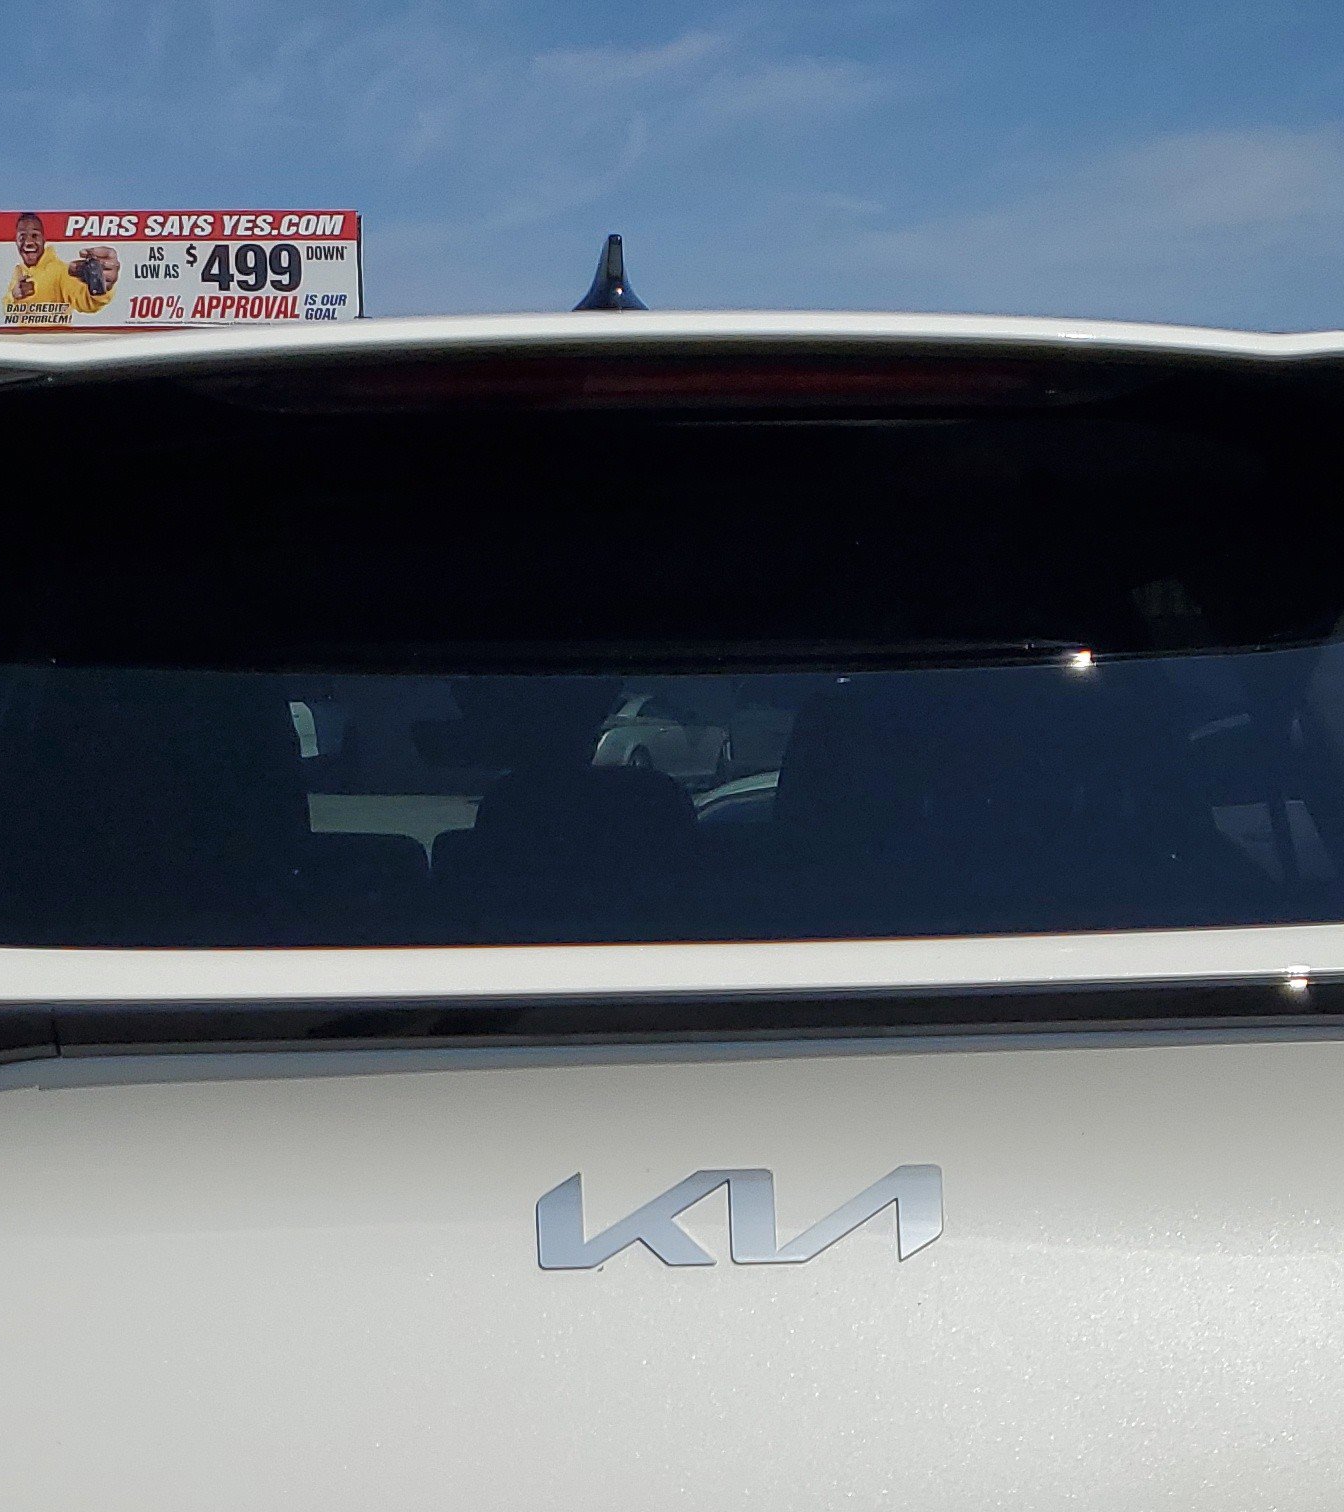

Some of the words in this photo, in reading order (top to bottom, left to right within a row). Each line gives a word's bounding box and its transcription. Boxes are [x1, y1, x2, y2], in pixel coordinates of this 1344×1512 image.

[65, 215, 138, 237] PARS
[144, 215, 214, 236] SAYS
[221, 214, 344, 236] YES.COM
[148, 246, 165, 262] AS
[134, 263, 160, 279] LOW
[163, 263, 180, 278] AS
[6, 303, 27, 313] BAD
[129, 295, 184, 319] 100%
[190, 295, 300, 319] APPROVAL
[304, 294, 317, 306] IS
[320, 294, 347, 306] OUR
[4, 314, 19, 324] NO
[21, 314, 73, 324] PROBLEM!
[305, 307, 338, 320] GOAL
[536, 1164, 944, 1270] KIA
